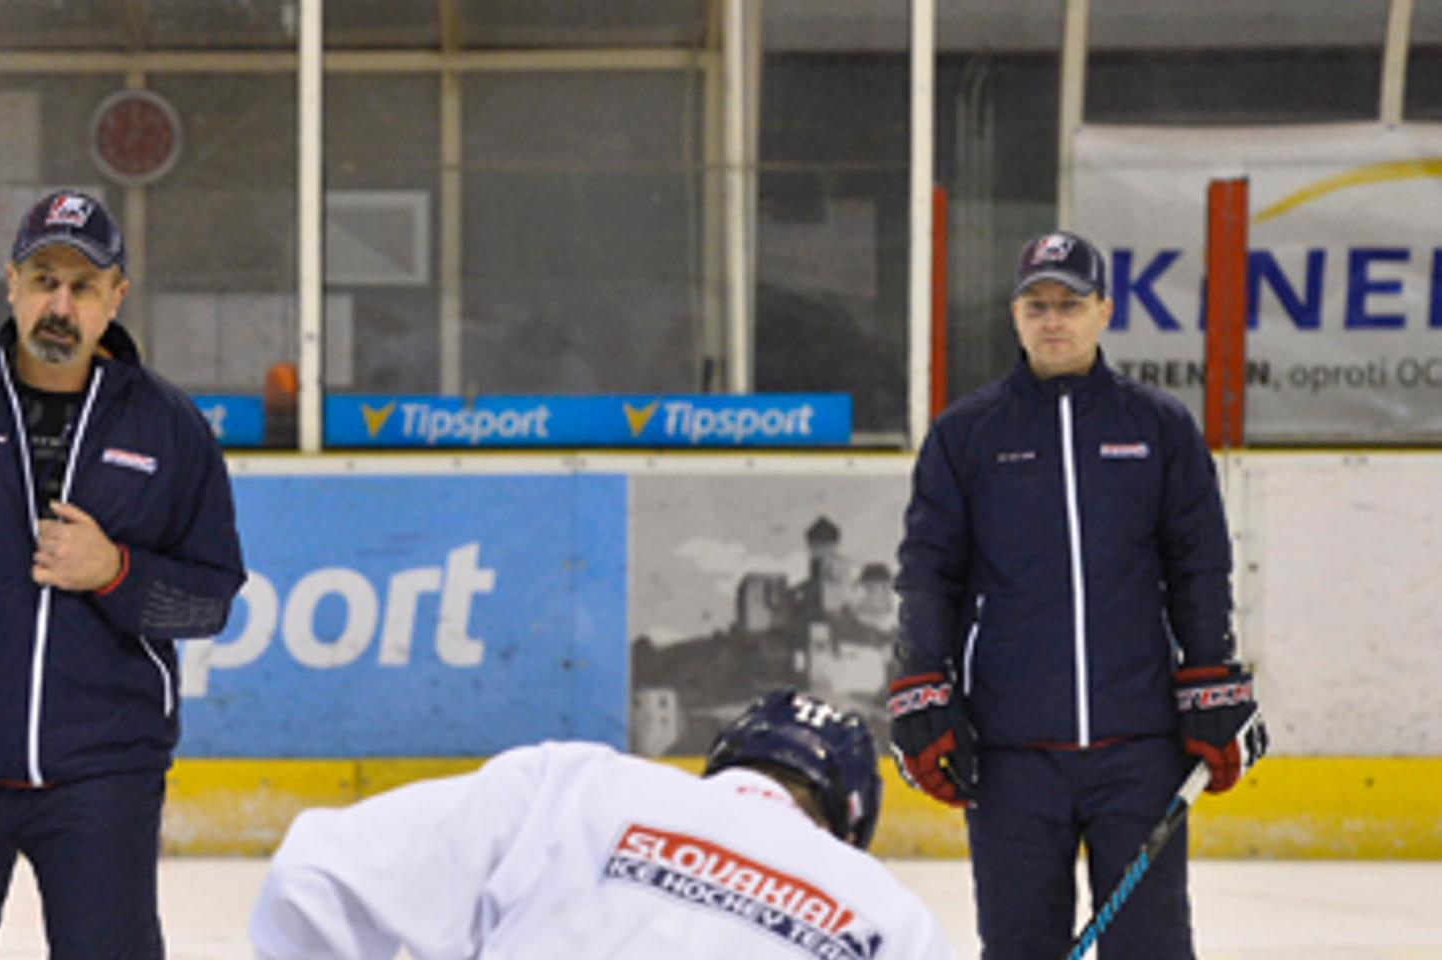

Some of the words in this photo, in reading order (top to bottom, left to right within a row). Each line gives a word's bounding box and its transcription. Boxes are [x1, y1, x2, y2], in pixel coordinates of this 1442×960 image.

[1107, 247, 1442, 332] KNE
[1289, 356, 1387, 393] oproti
[400, 403, 552, 446] Tipsport
[664, 402, 814, 445] Tipsport
[609, 857, 650, 881] ICE
[659, 872, 786, 928] HOCKEY
[618, 831, 844, 933] SLOVAKIA
